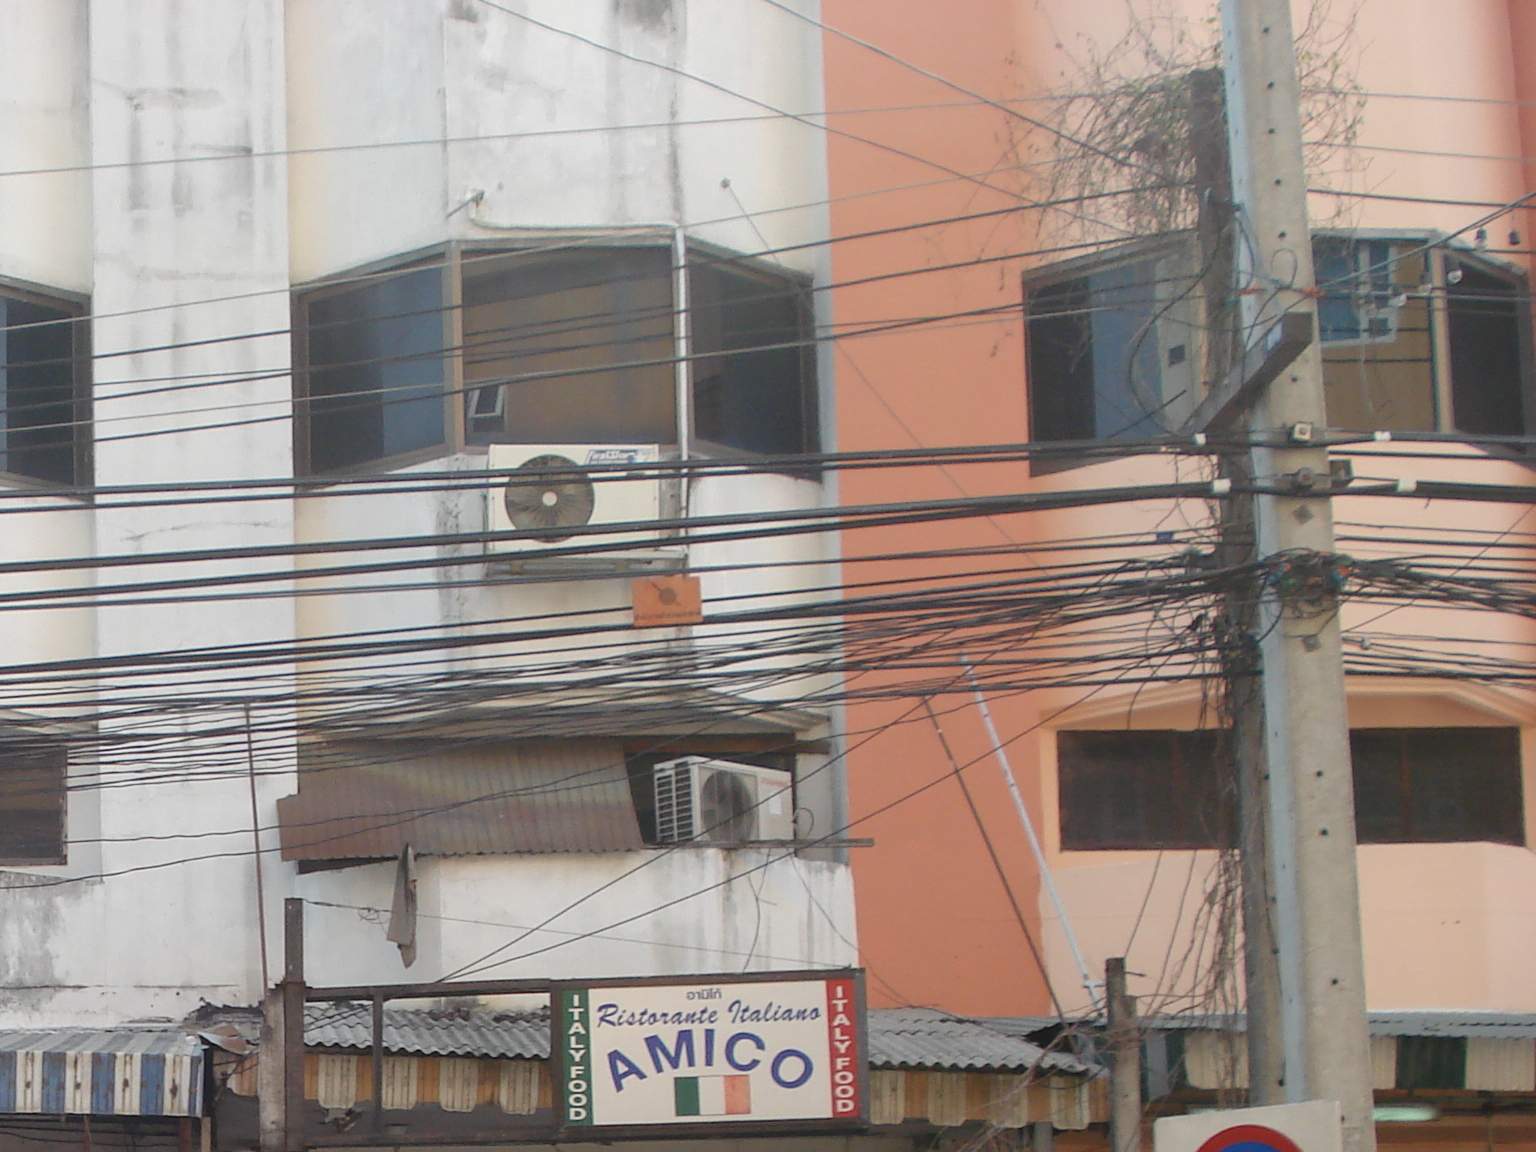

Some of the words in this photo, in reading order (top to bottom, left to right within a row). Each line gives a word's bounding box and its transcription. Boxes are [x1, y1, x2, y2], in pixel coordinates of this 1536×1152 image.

[567, 993, 587, 1062] ITALY
[596, 1003, 718, 1028] Ristorante
[727, 999, 822, 1025] Italiano
[831, 985, 852, 1055] ITALY
[606, 1028, 814, 1093] AMICO
[834, 1056, 855, 1113] FOOD
[569, 1065, 588, 1122] FOOD
